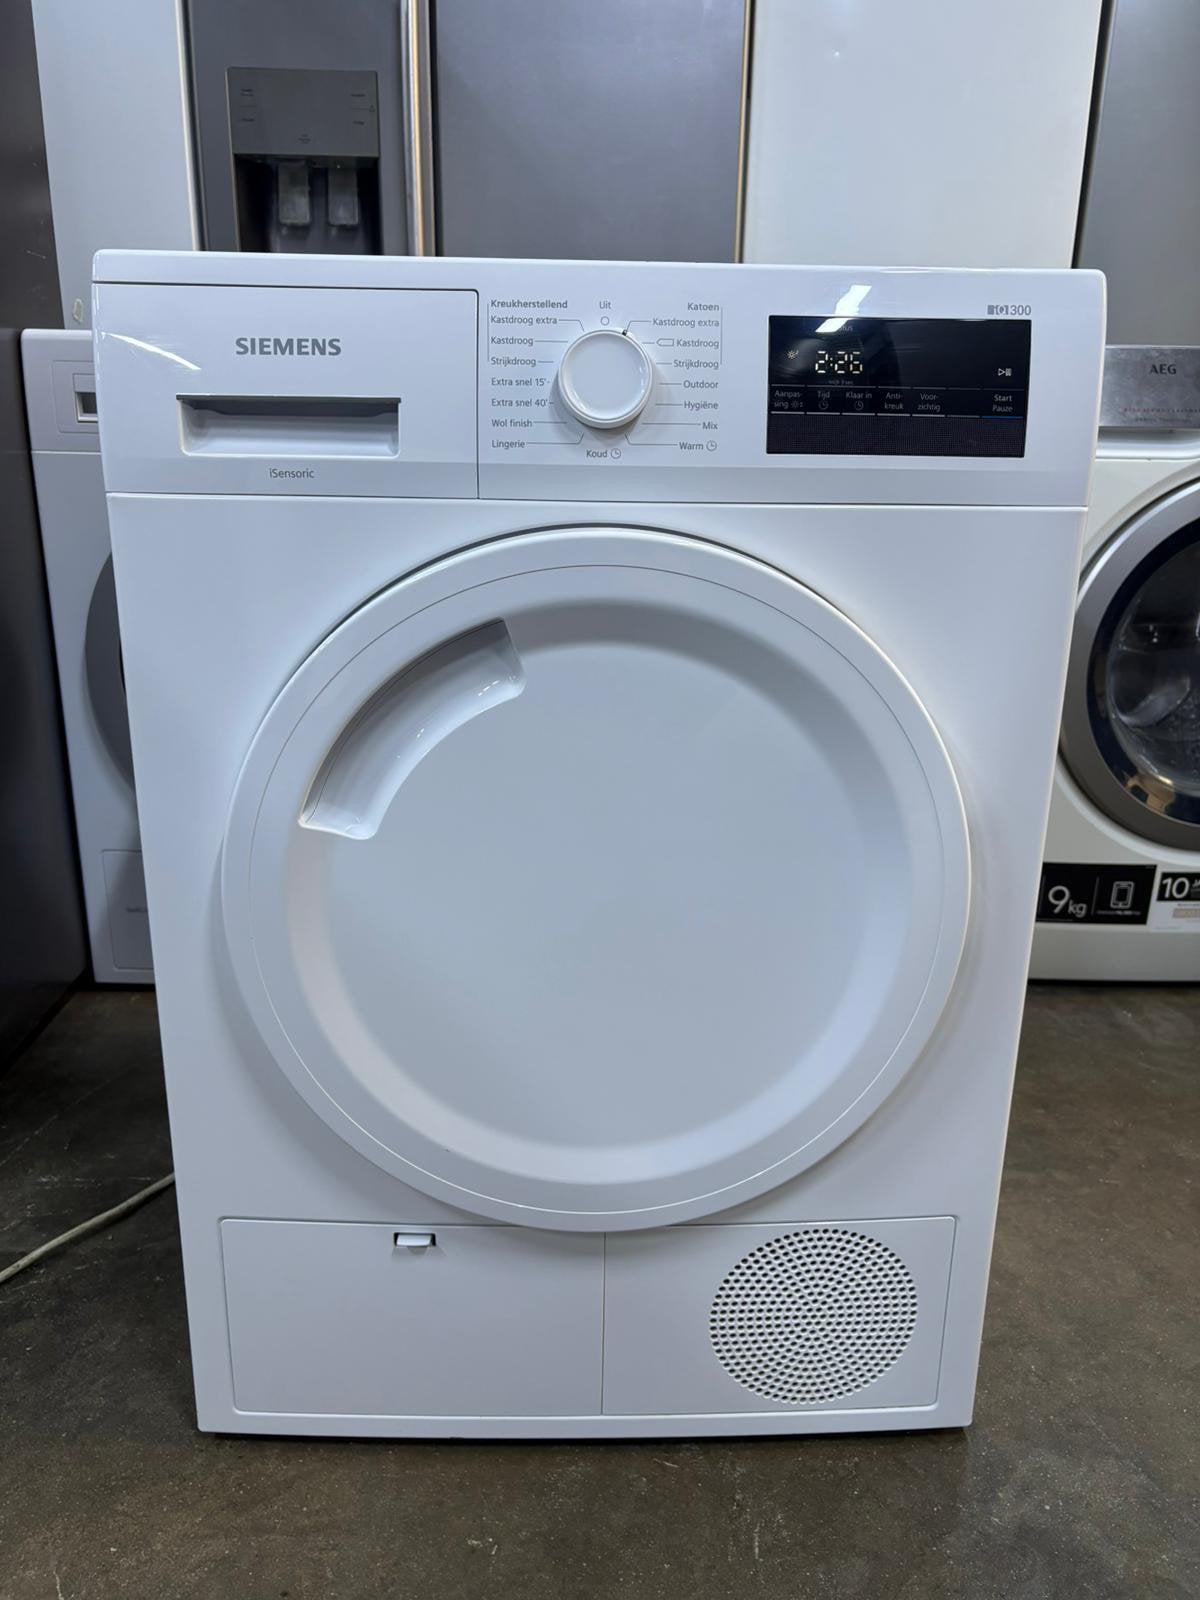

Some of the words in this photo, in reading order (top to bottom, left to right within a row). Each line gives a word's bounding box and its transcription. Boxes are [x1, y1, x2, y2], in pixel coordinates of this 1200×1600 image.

[490, 299, 568, 309] Kreukherstellend
[599, 300, 612, 309] Uit
[687, 302, 720, 311] Katoen
[490, 315, 534, 326] Kastdroog
[535, 317, 558, 325] extra
[653, 318, 696, 328] Kastdroog
[697, 319, 720, 327] extra
[235, 337, 342, 356] SIEMENS
[490, 336, 534, 347] Kastdroog
[676, 338, 720, 349] Kastdroog
[490, 356, 537, 367] Strijkdroog
[673, 359, 719, 370] Strijkdroog
[815, 350, 863, 374] 2:26
[1149, 363, 1177, 375] AEG
[491, 377, 513, 386] Extra
[514, 378, 533, 386] snel
[683, 380, 719, 389] Outdoor
[817, 390, 831, 401] Tijd
[993, 393, 1013, 403] Start
[491, 398, 513, 407] Extra
[514, 399, 533, 407] snel
[684, 400, 719, 411] Hygiëne
[992, 404, 1014, 413] Pauze
[491, 419, 508, 428] Wol
[509, 418, 533, 428] finish
[702, 421, 718, 430] Mix
[491, 439, 526, 450] Lingerie
[679, 441, 704, 450] Warm
[586, 448, 608, 458] Koud
[269, 467, 315, 479] iSensoric
[1162, 877, 1190, 899] 10
